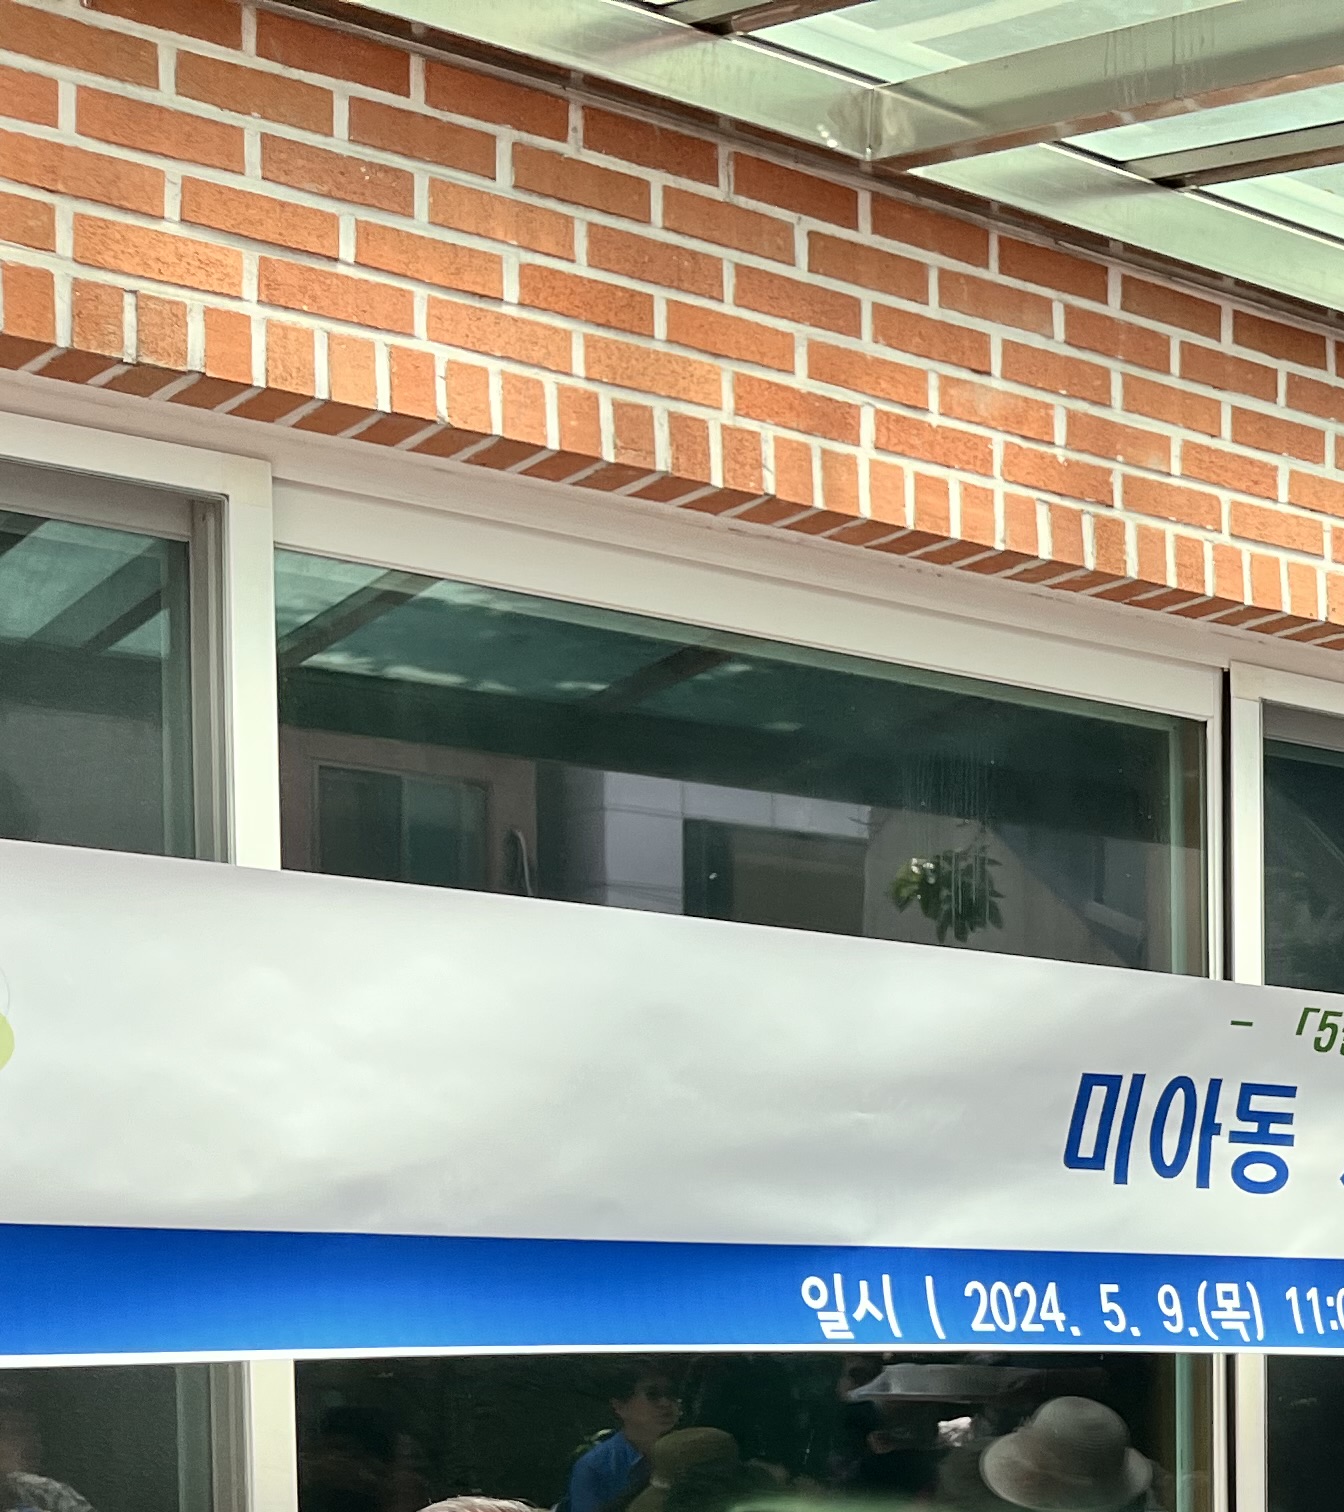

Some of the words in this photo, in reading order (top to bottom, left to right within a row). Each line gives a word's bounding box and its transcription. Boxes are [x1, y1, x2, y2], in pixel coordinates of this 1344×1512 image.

[1063, 1072, 1298, 1195] 미아동
[801, 1272, 902, 1340] 일시
[964, 1280, 1081, 1337] 2024.
[1100, 1283, 1141, 1337] 5.
[1157, 1280, 1264, 1342] 9.(목)
